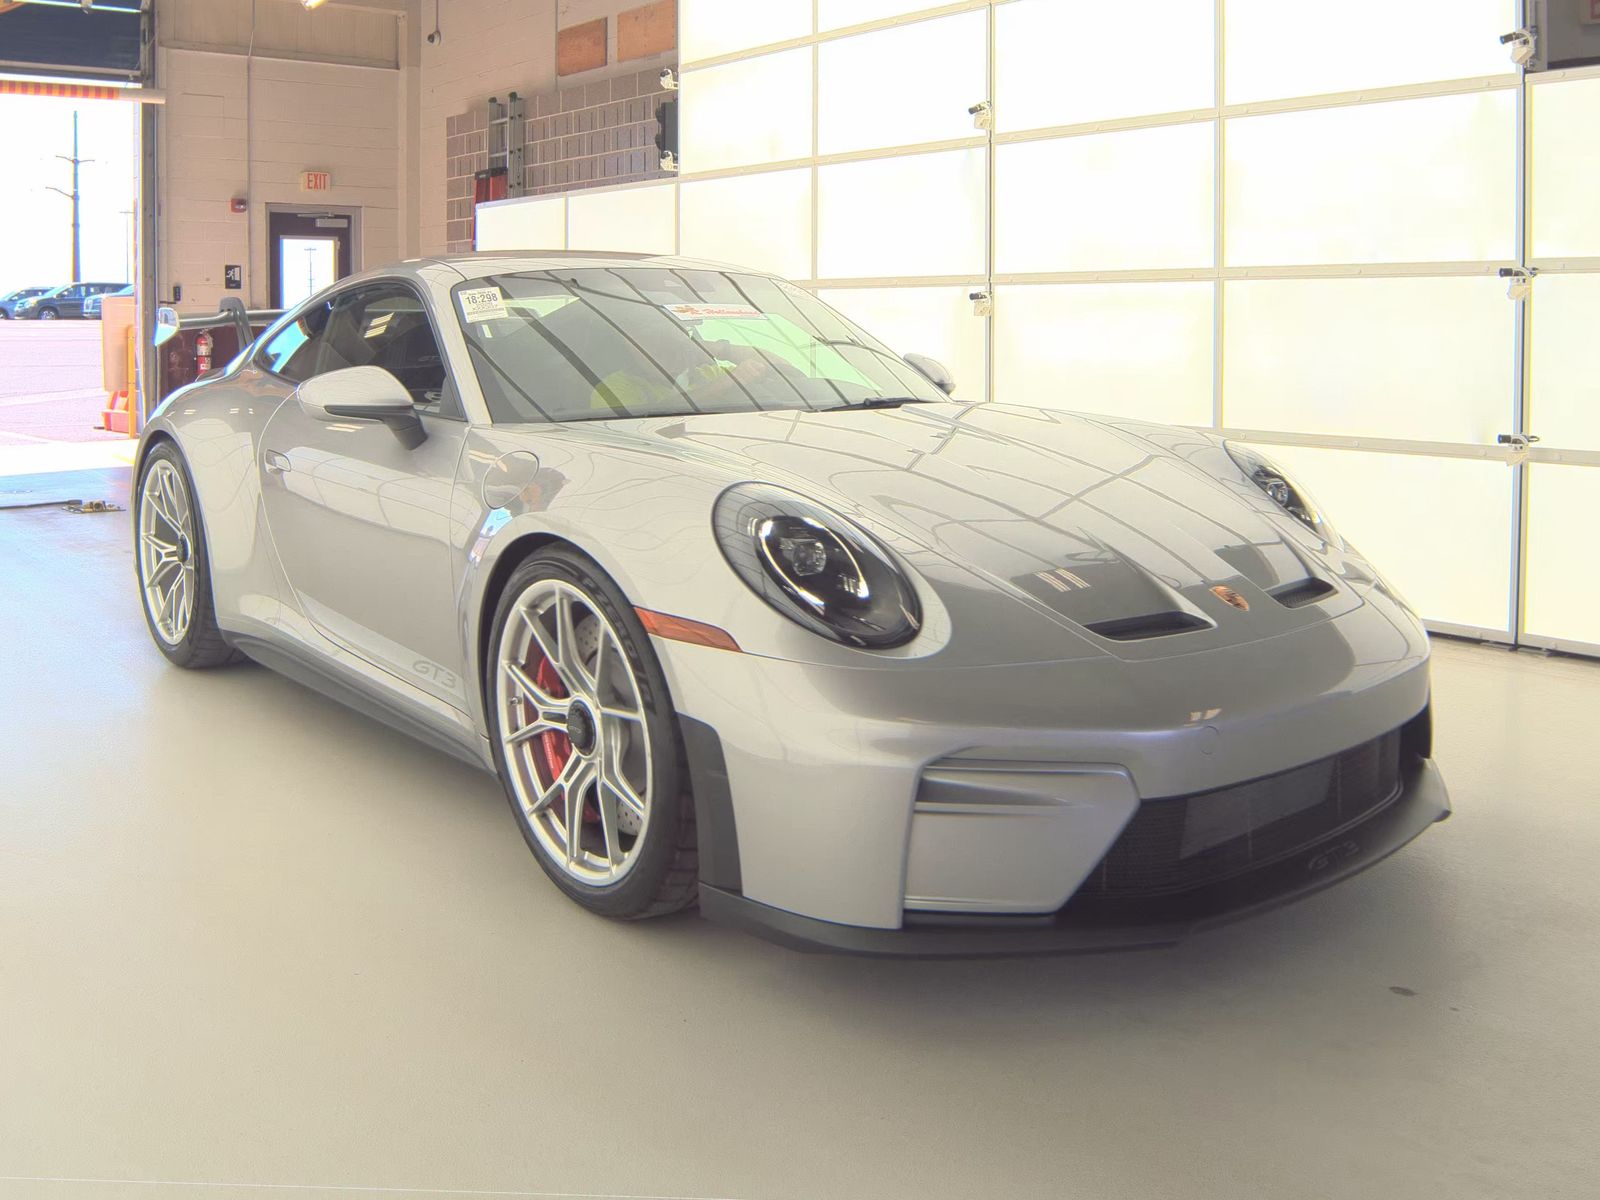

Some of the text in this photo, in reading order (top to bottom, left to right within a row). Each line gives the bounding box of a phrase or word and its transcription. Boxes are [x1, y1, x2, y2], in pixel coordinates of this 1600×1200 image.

[307, 172, 328, 190] EXIT
[412, 660, 457, 689] GT3
[1308, 841, 1359, 871] GT3
